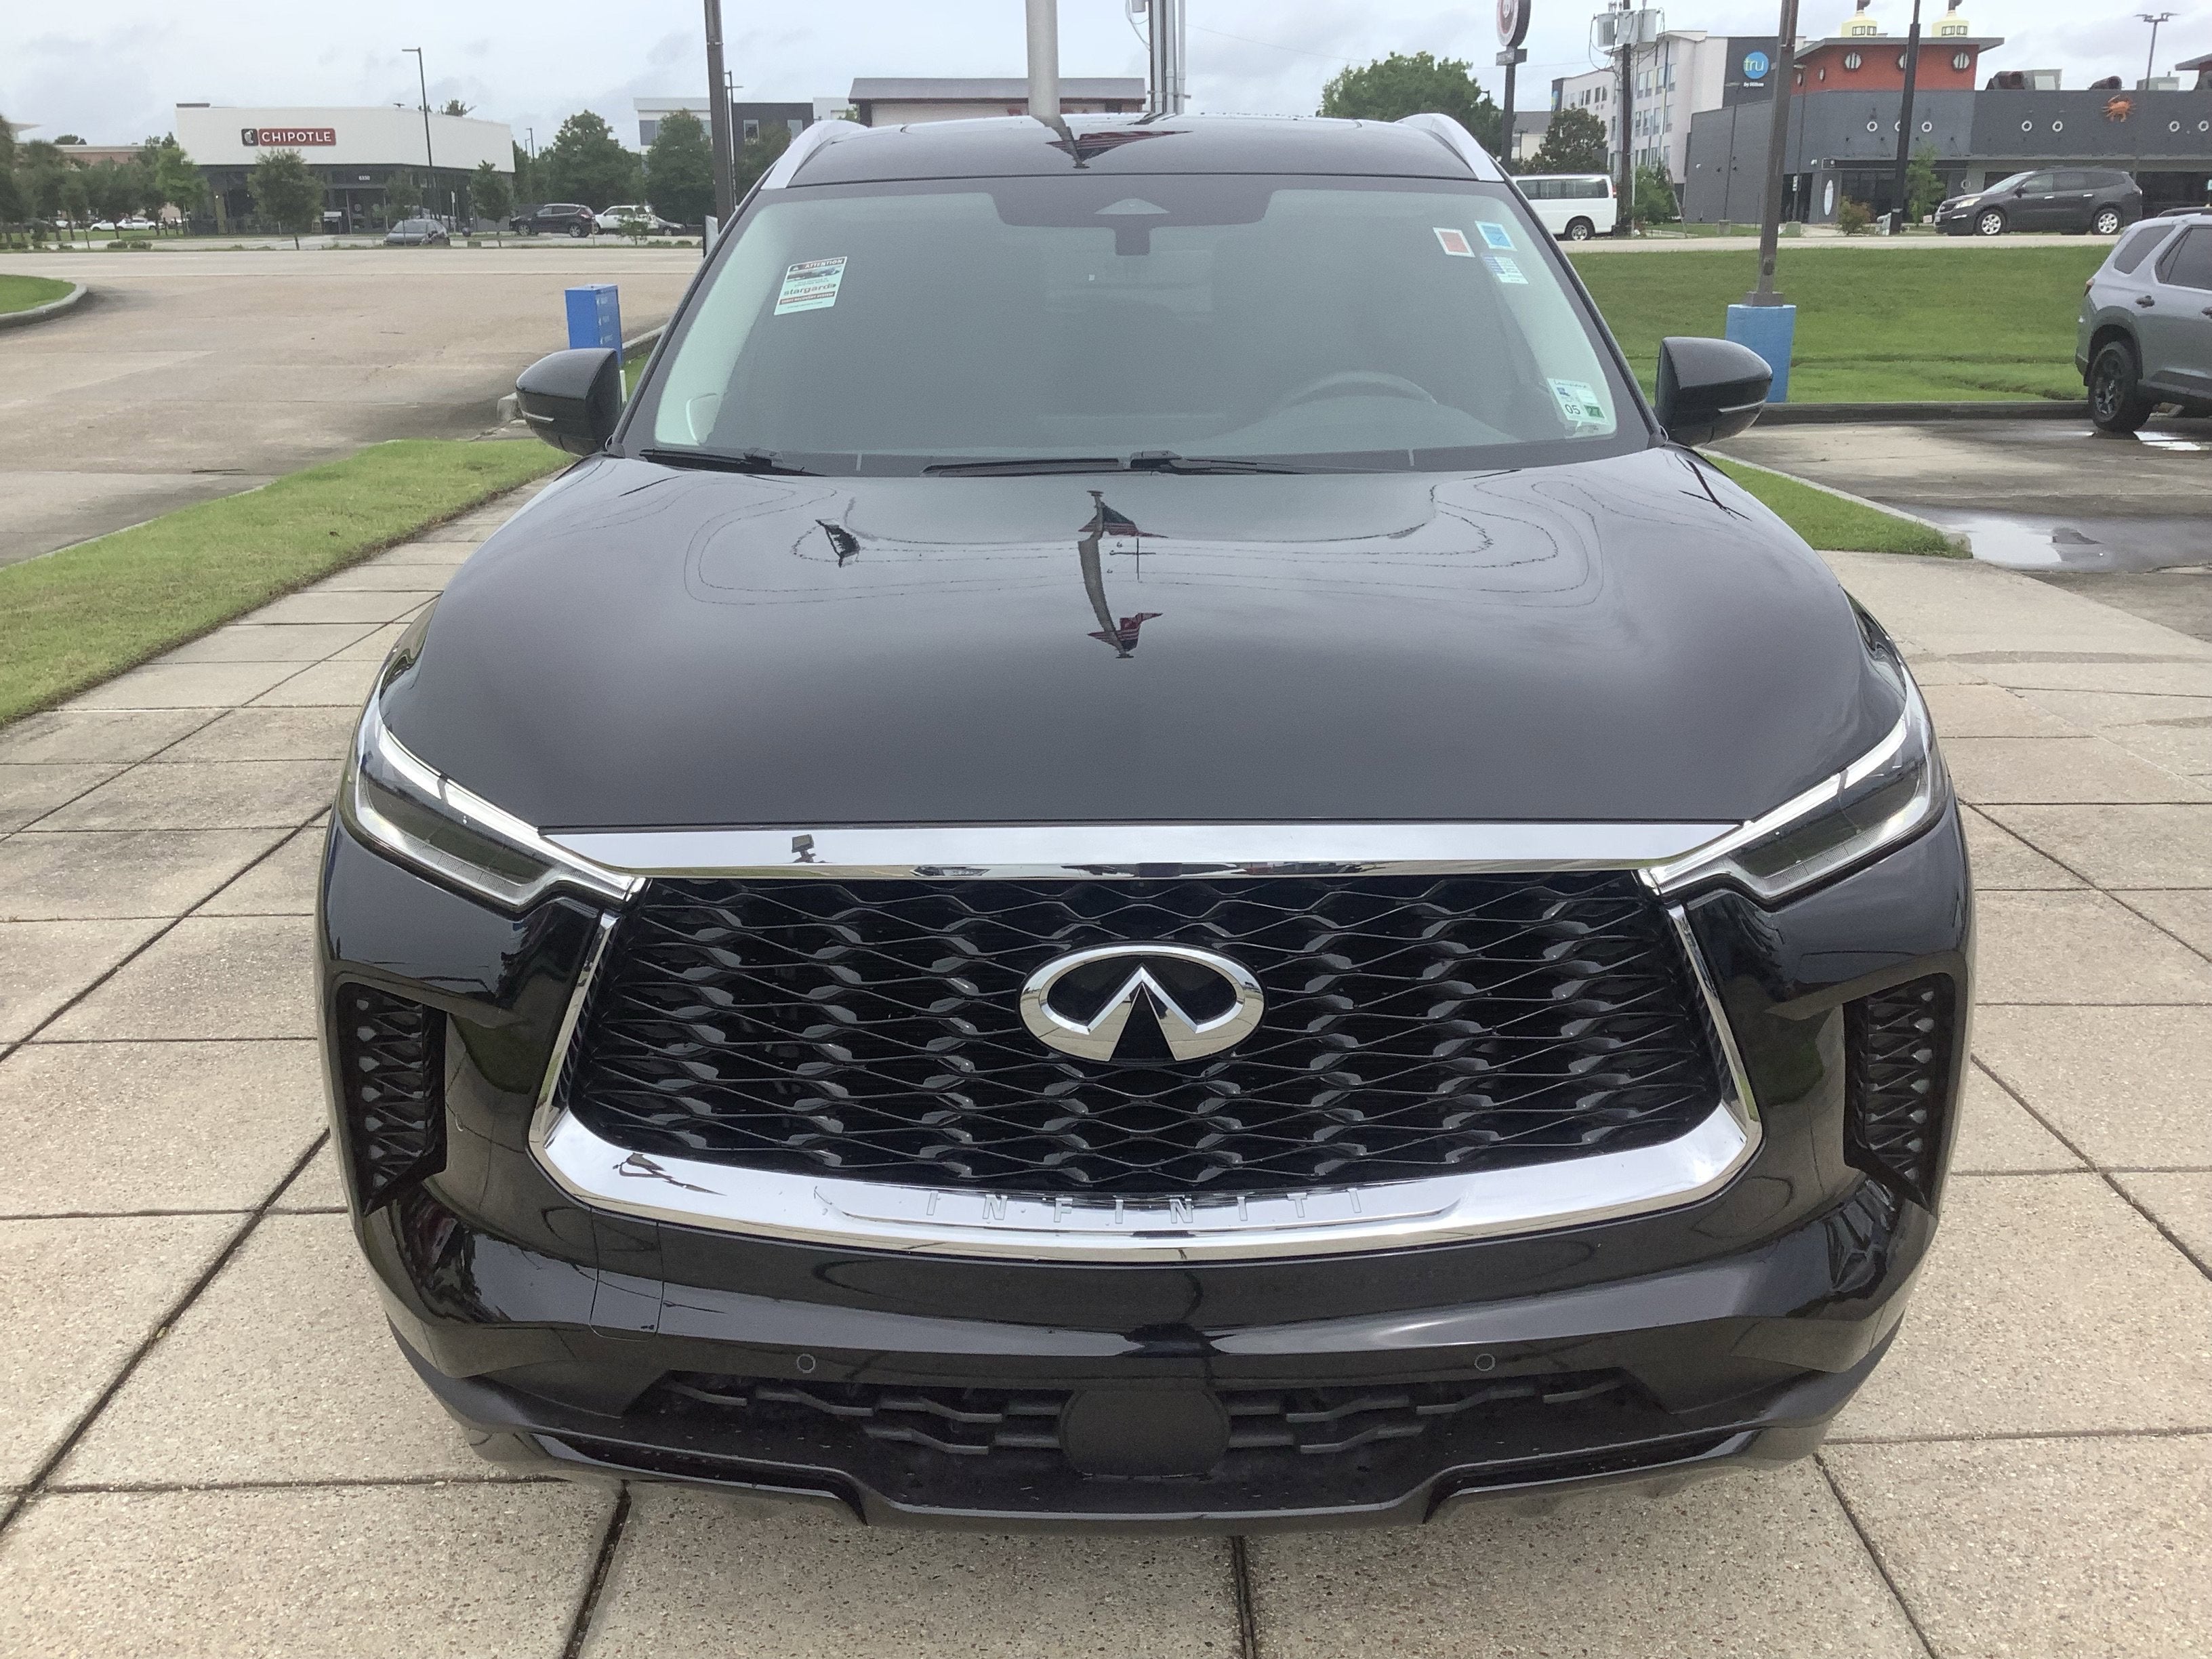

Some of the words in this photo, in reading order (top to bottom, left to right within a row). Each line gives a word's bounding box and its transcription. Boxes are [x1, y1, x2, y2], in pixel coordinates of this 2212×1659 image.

[1744, 57, 1764, 71] tru
[262, 131, 331, 142] CHIPOTLE
[804, 259, 843, 269] ATTENTION
[1565, 404, 1580, 415] 05
[926, 1187, 1361, 1224] INFINITI
